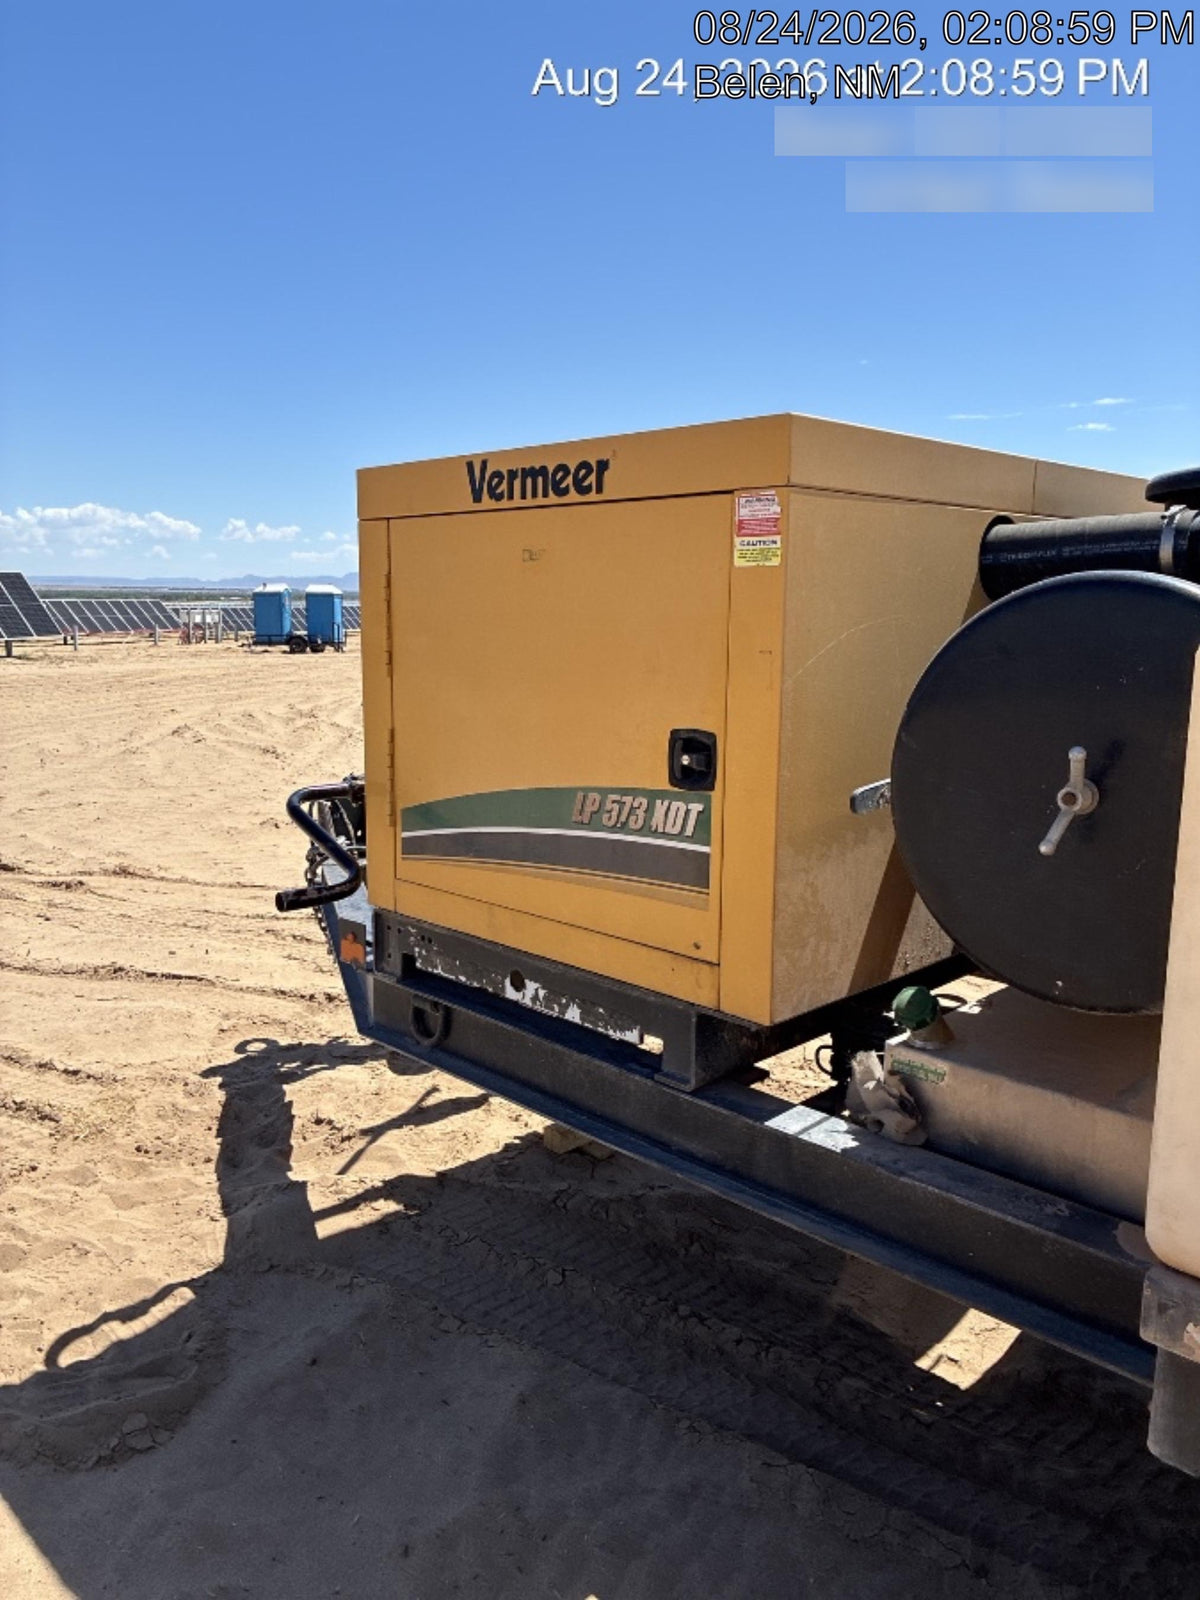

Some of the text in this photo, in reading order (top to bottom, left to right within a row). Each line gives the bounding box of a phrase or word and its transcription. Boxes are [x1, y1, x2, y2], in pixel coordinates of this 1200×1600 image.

[465, 457, 611, 504] Vermeer
[572, 791, 601, 824] LP
[602, 794, 648, 831] 573
